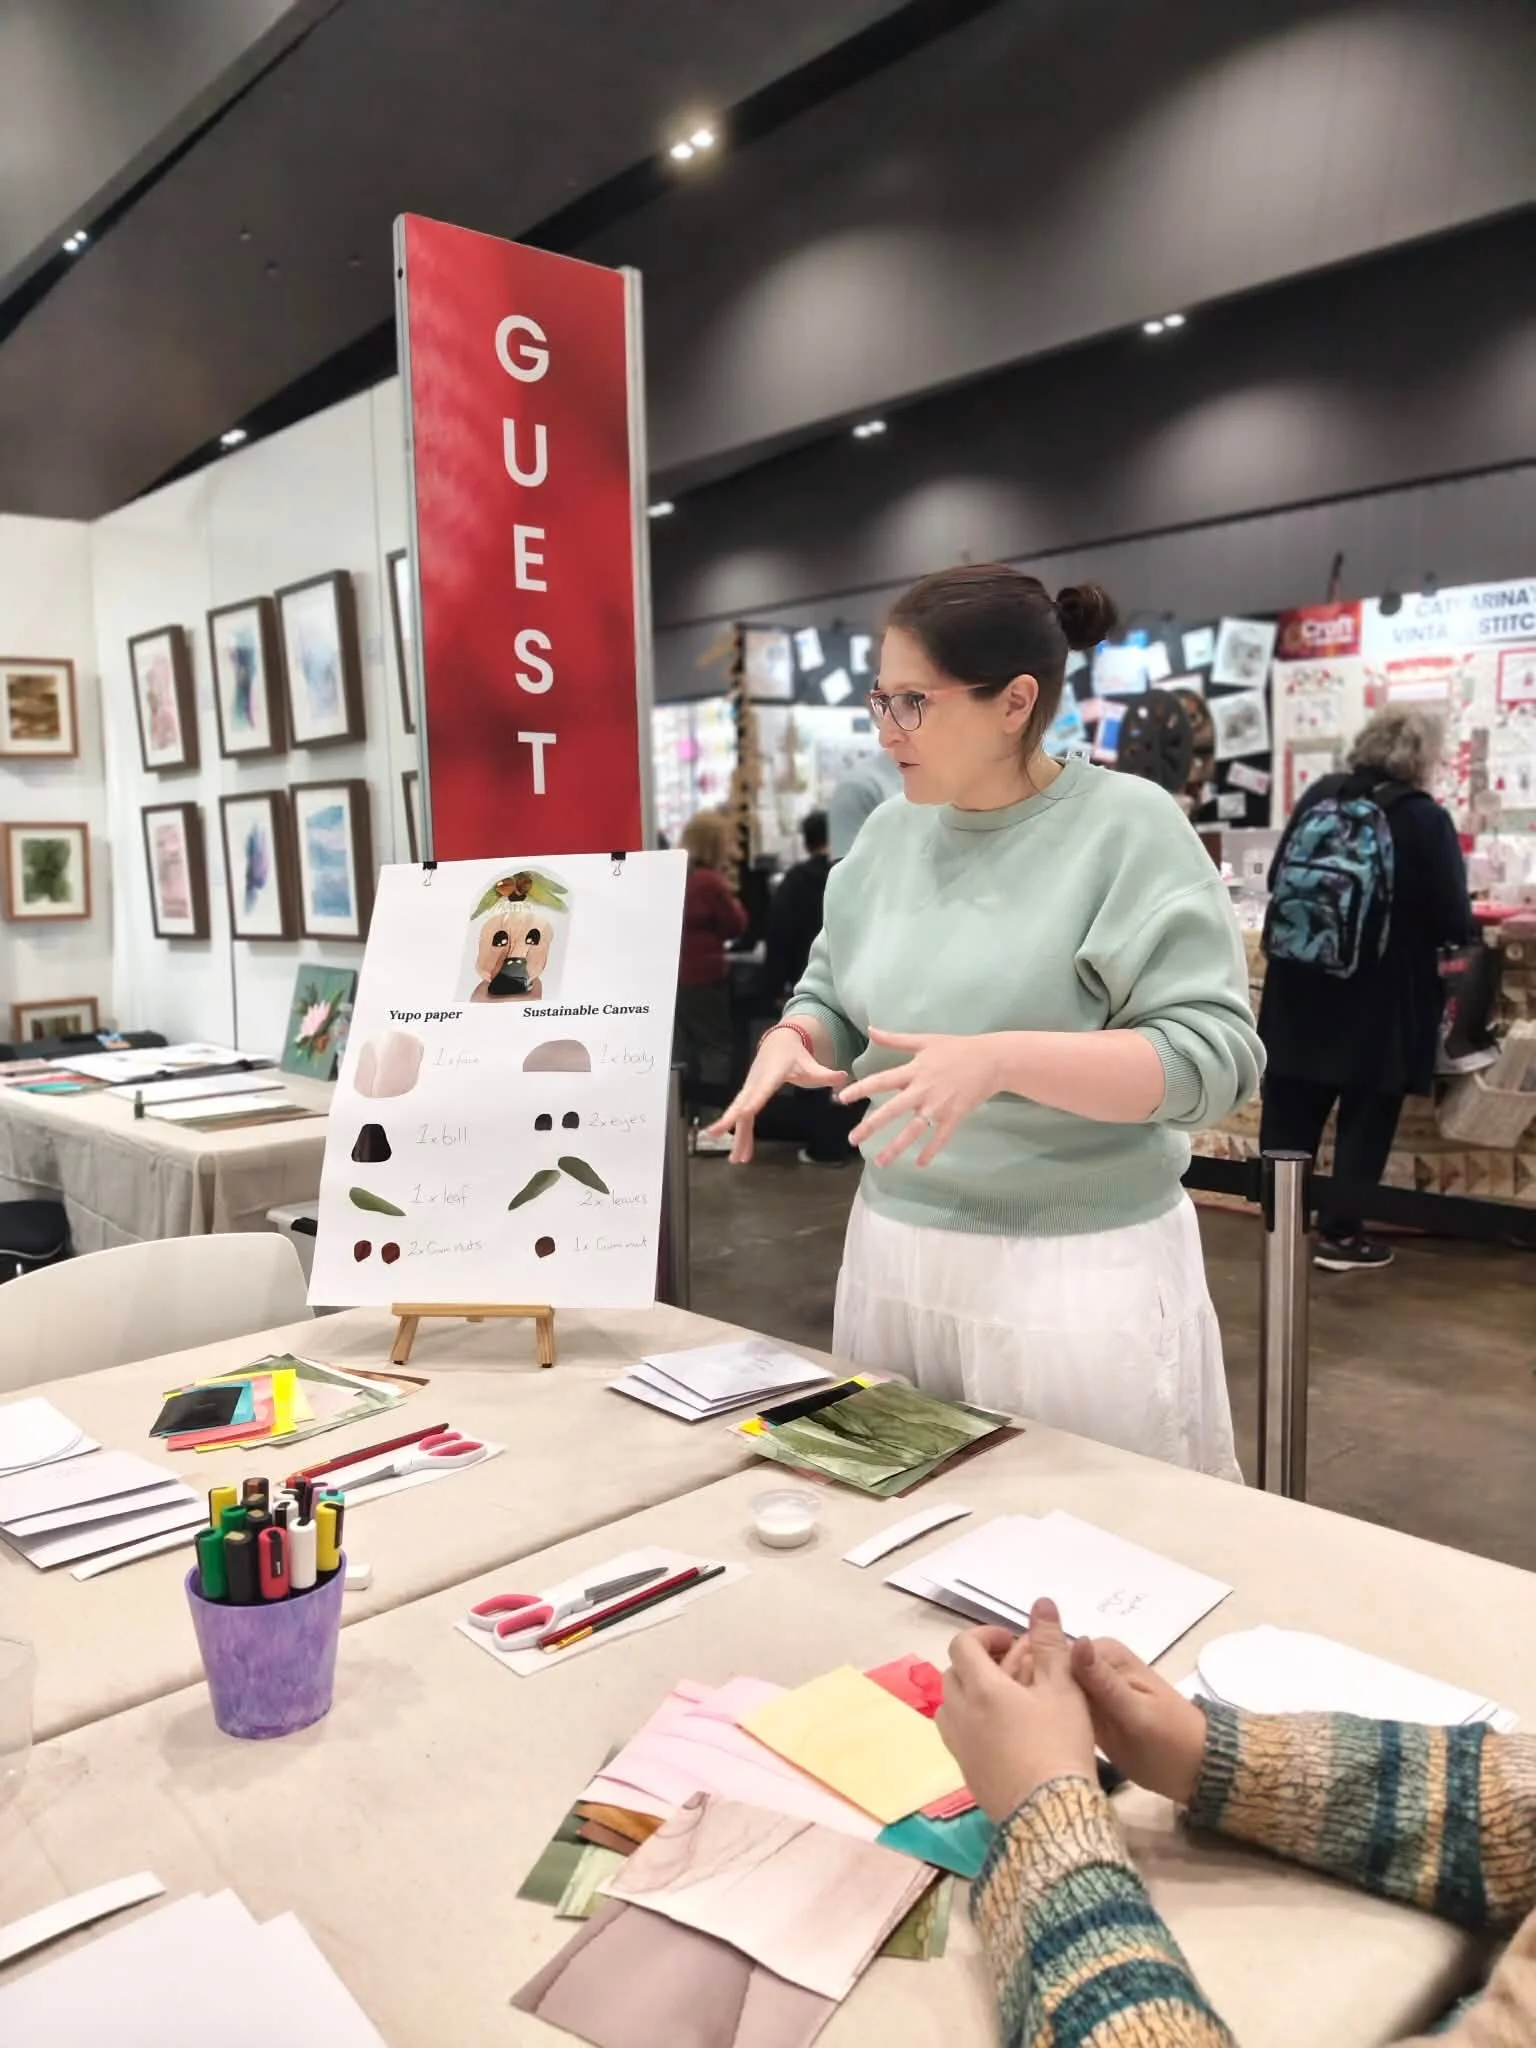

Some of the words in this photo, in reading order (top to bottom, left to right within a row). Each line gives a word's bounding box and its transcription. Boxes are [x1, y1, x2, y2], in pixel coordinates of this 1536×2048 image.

[495, 314, 557, 796] GUEST
[389, 1010, 422, 1023] Yupo
[424, 1009, 463, 1023] paper
[523, 1004, 599, 1018] Sustainable
[602, 1003, 650, 1015] Canvas
